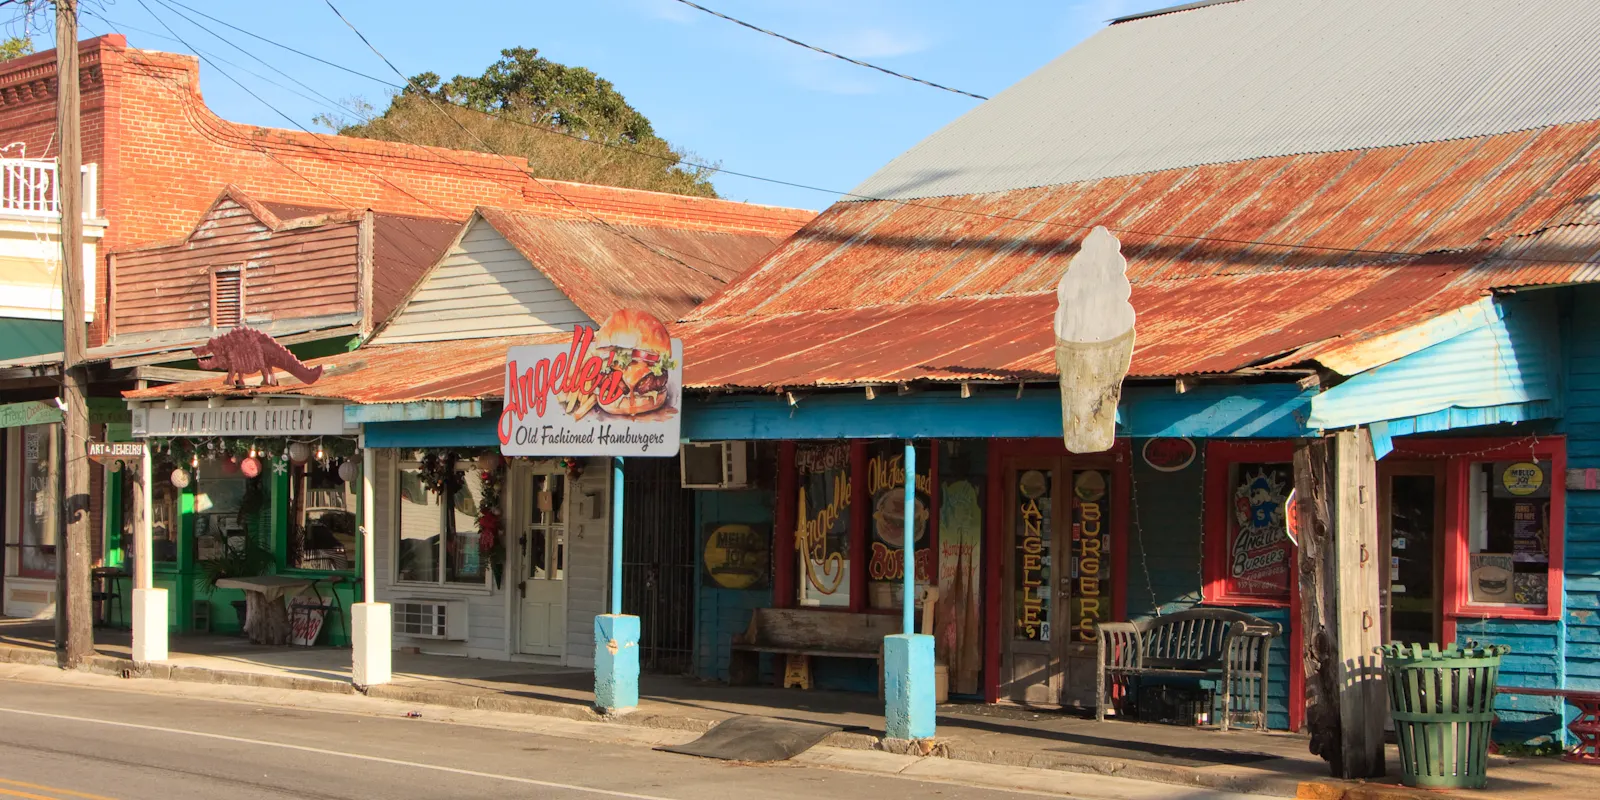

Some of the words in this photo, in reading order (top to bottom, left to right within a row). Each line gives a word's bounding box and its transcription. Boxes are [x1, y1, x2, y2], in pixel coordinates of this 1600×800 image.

[498, 325, 623, 445] Angelle's
[171, 410, 194, 431] PINK
[202, 410, 257, 431] ALLIGATOR
[265, 409, 313, 430] GALLERY
[516, 426, 538, 444] Old
[541, 425, 593, 445] Fashioned
[597, 425, 664, 451] Hamburgers
[90, 444, 104, 455] ART
[111, 444, 142, 455] JEWELRY
[868, 455, 887, 495] Old
[1511, 469, 1535, 477] MELLO
[1256, 509, 1265, 520] S
[1233, 549, 1285, 578] BURGERS
[1471, 556, 1513, 572] HAMBURGERS
